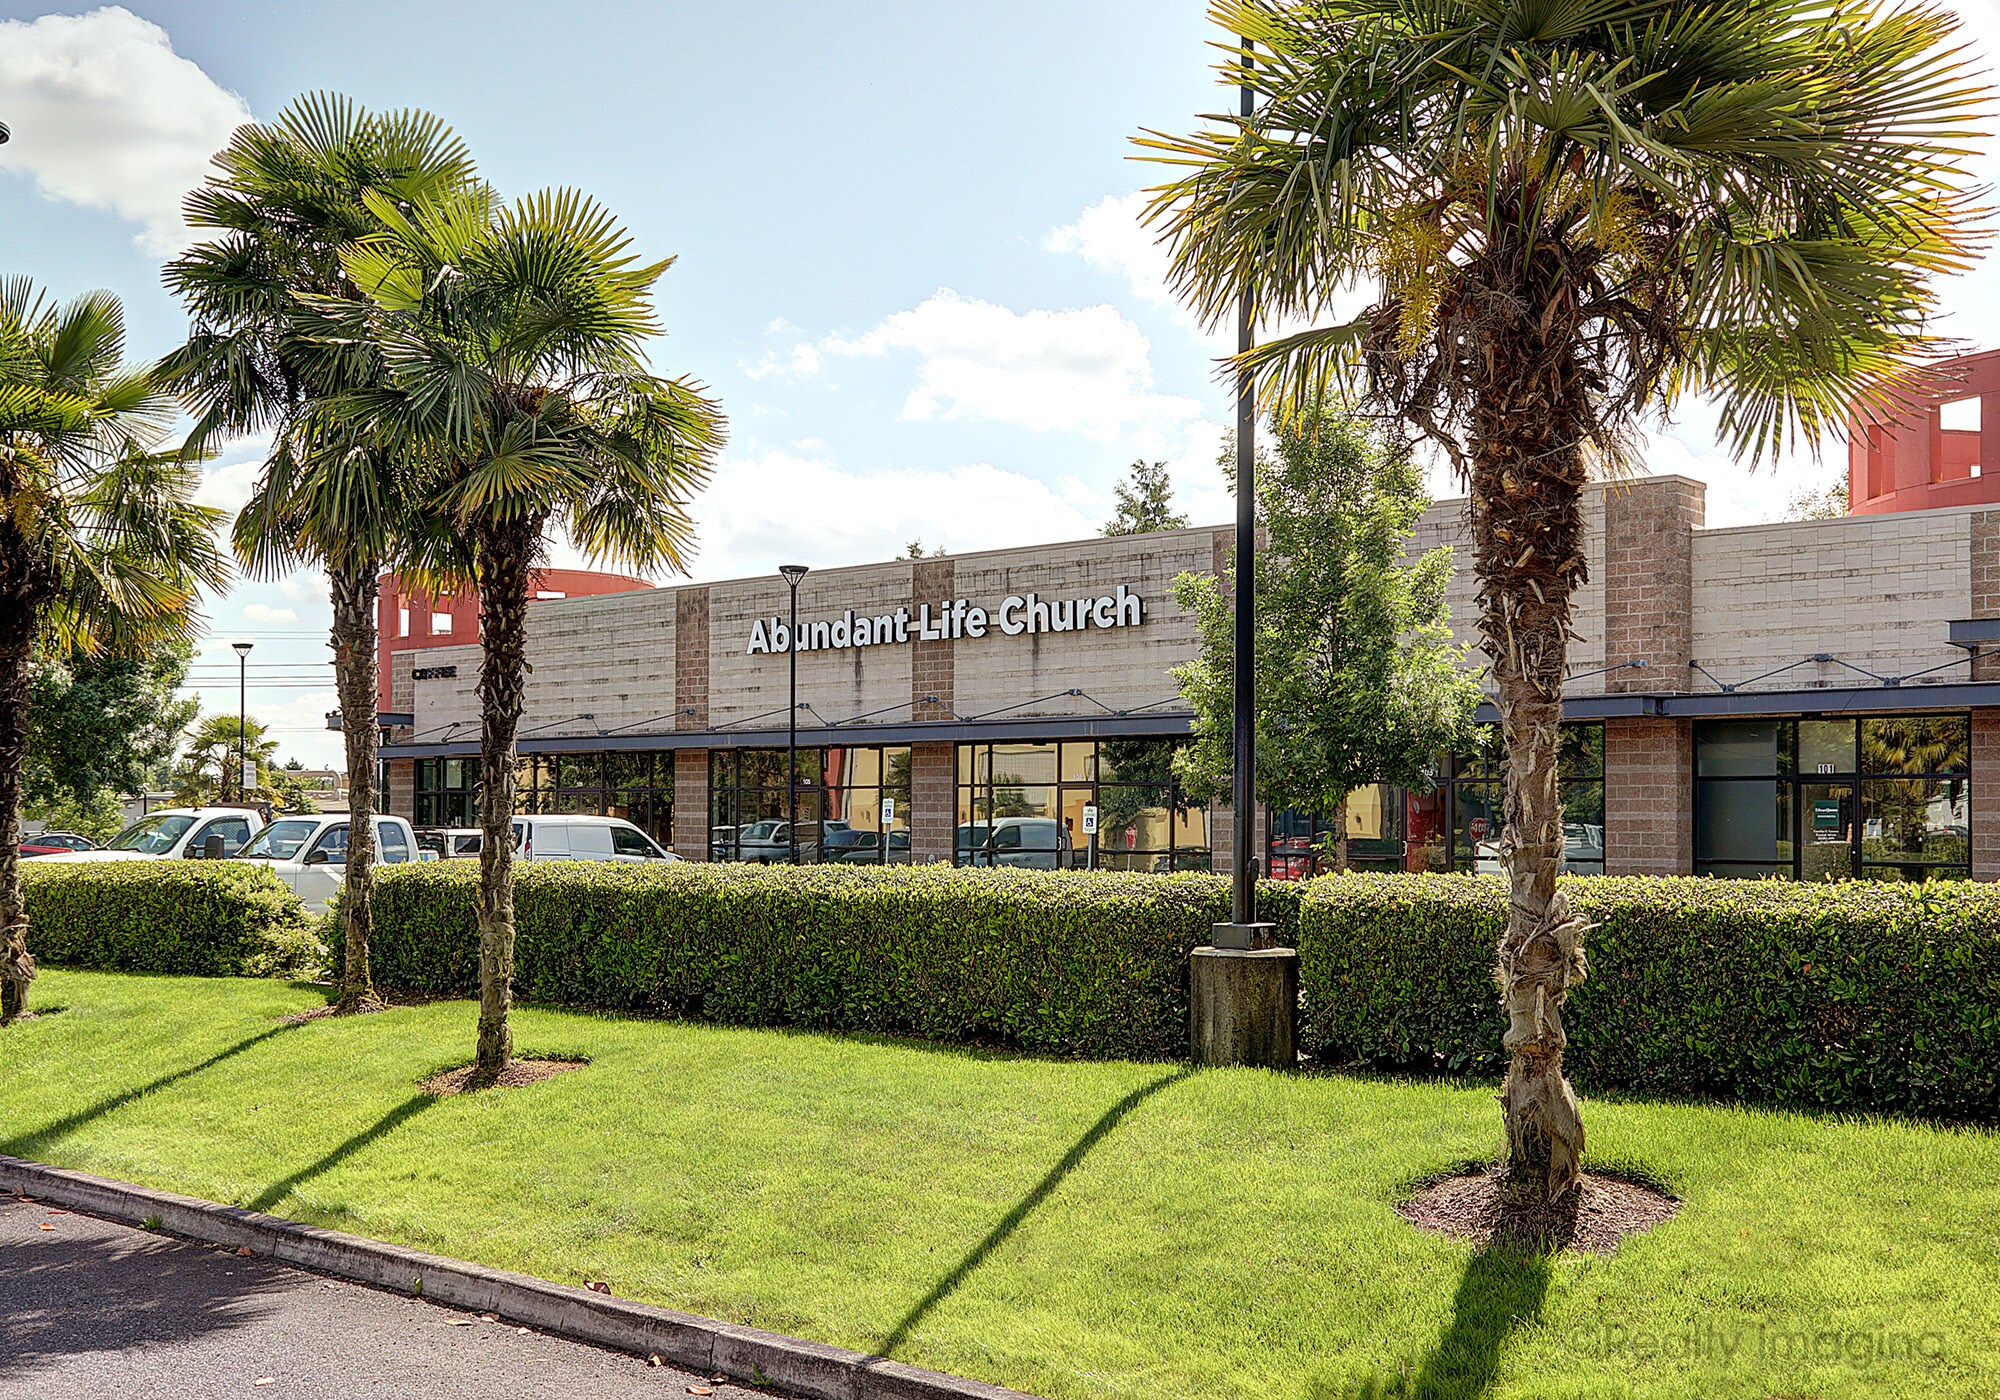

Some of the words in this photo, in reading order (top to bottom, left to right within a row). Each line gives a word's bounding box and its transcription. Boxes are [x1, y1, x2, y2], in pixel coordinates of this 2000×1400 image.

[747, 606, 911, 655] Abundant
[919, 599, 990, 642] Life
[999, 585, 1146, 636] Church
[1819, 764, 1833, 773] 101
